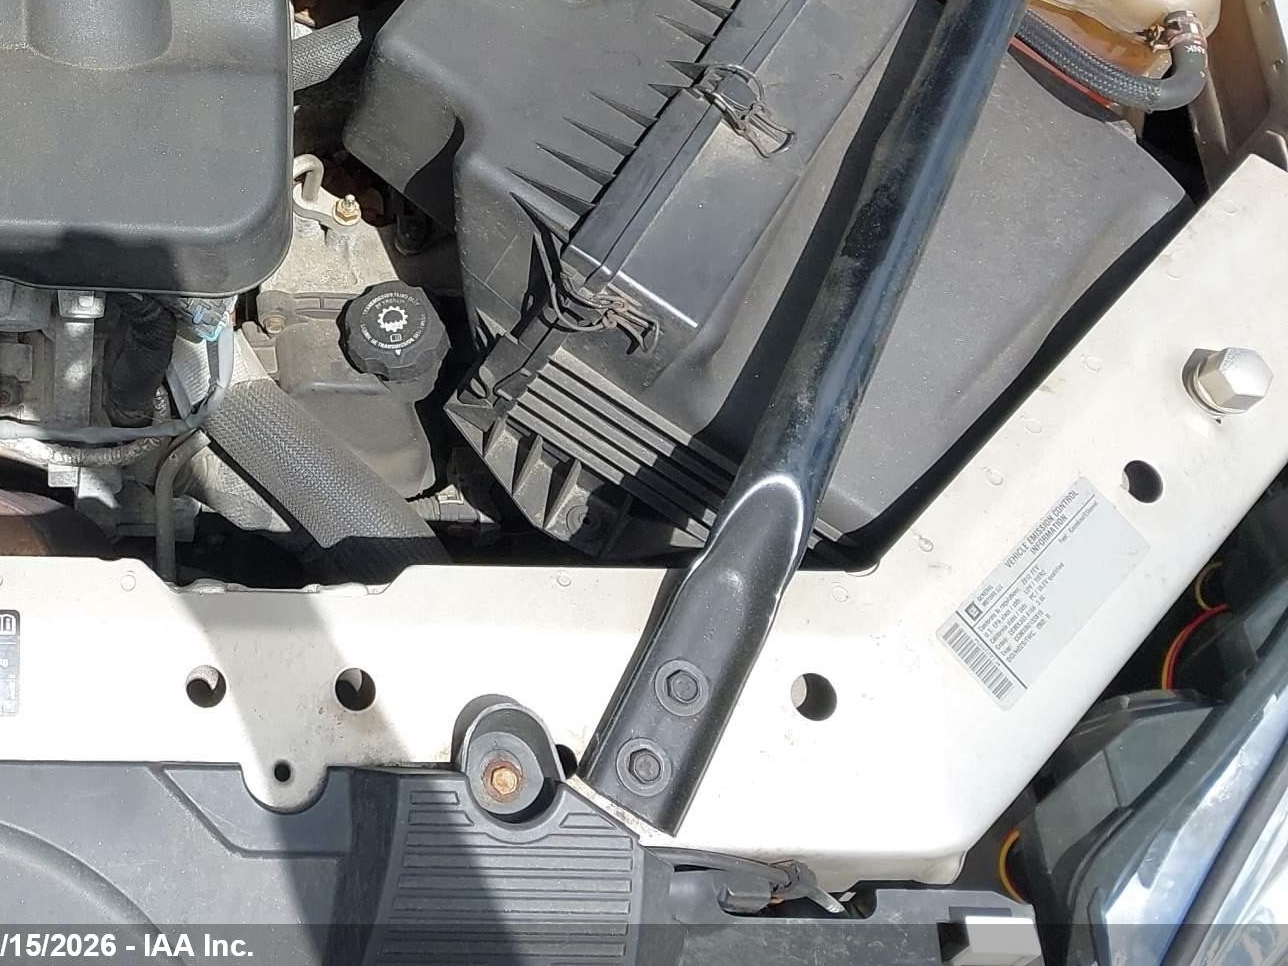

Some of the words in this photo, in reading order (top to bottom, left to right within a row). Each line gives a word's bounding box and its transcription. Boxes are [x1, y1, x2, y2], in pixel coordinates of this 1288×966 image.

[1003, 541, 1030, 570] VEHICLE
[1025, 514, 1055, 546] EMISSION
[1051, 487, 1080, 518] CONTROL
[1029, 513, 1068, 555] INFORMATION
